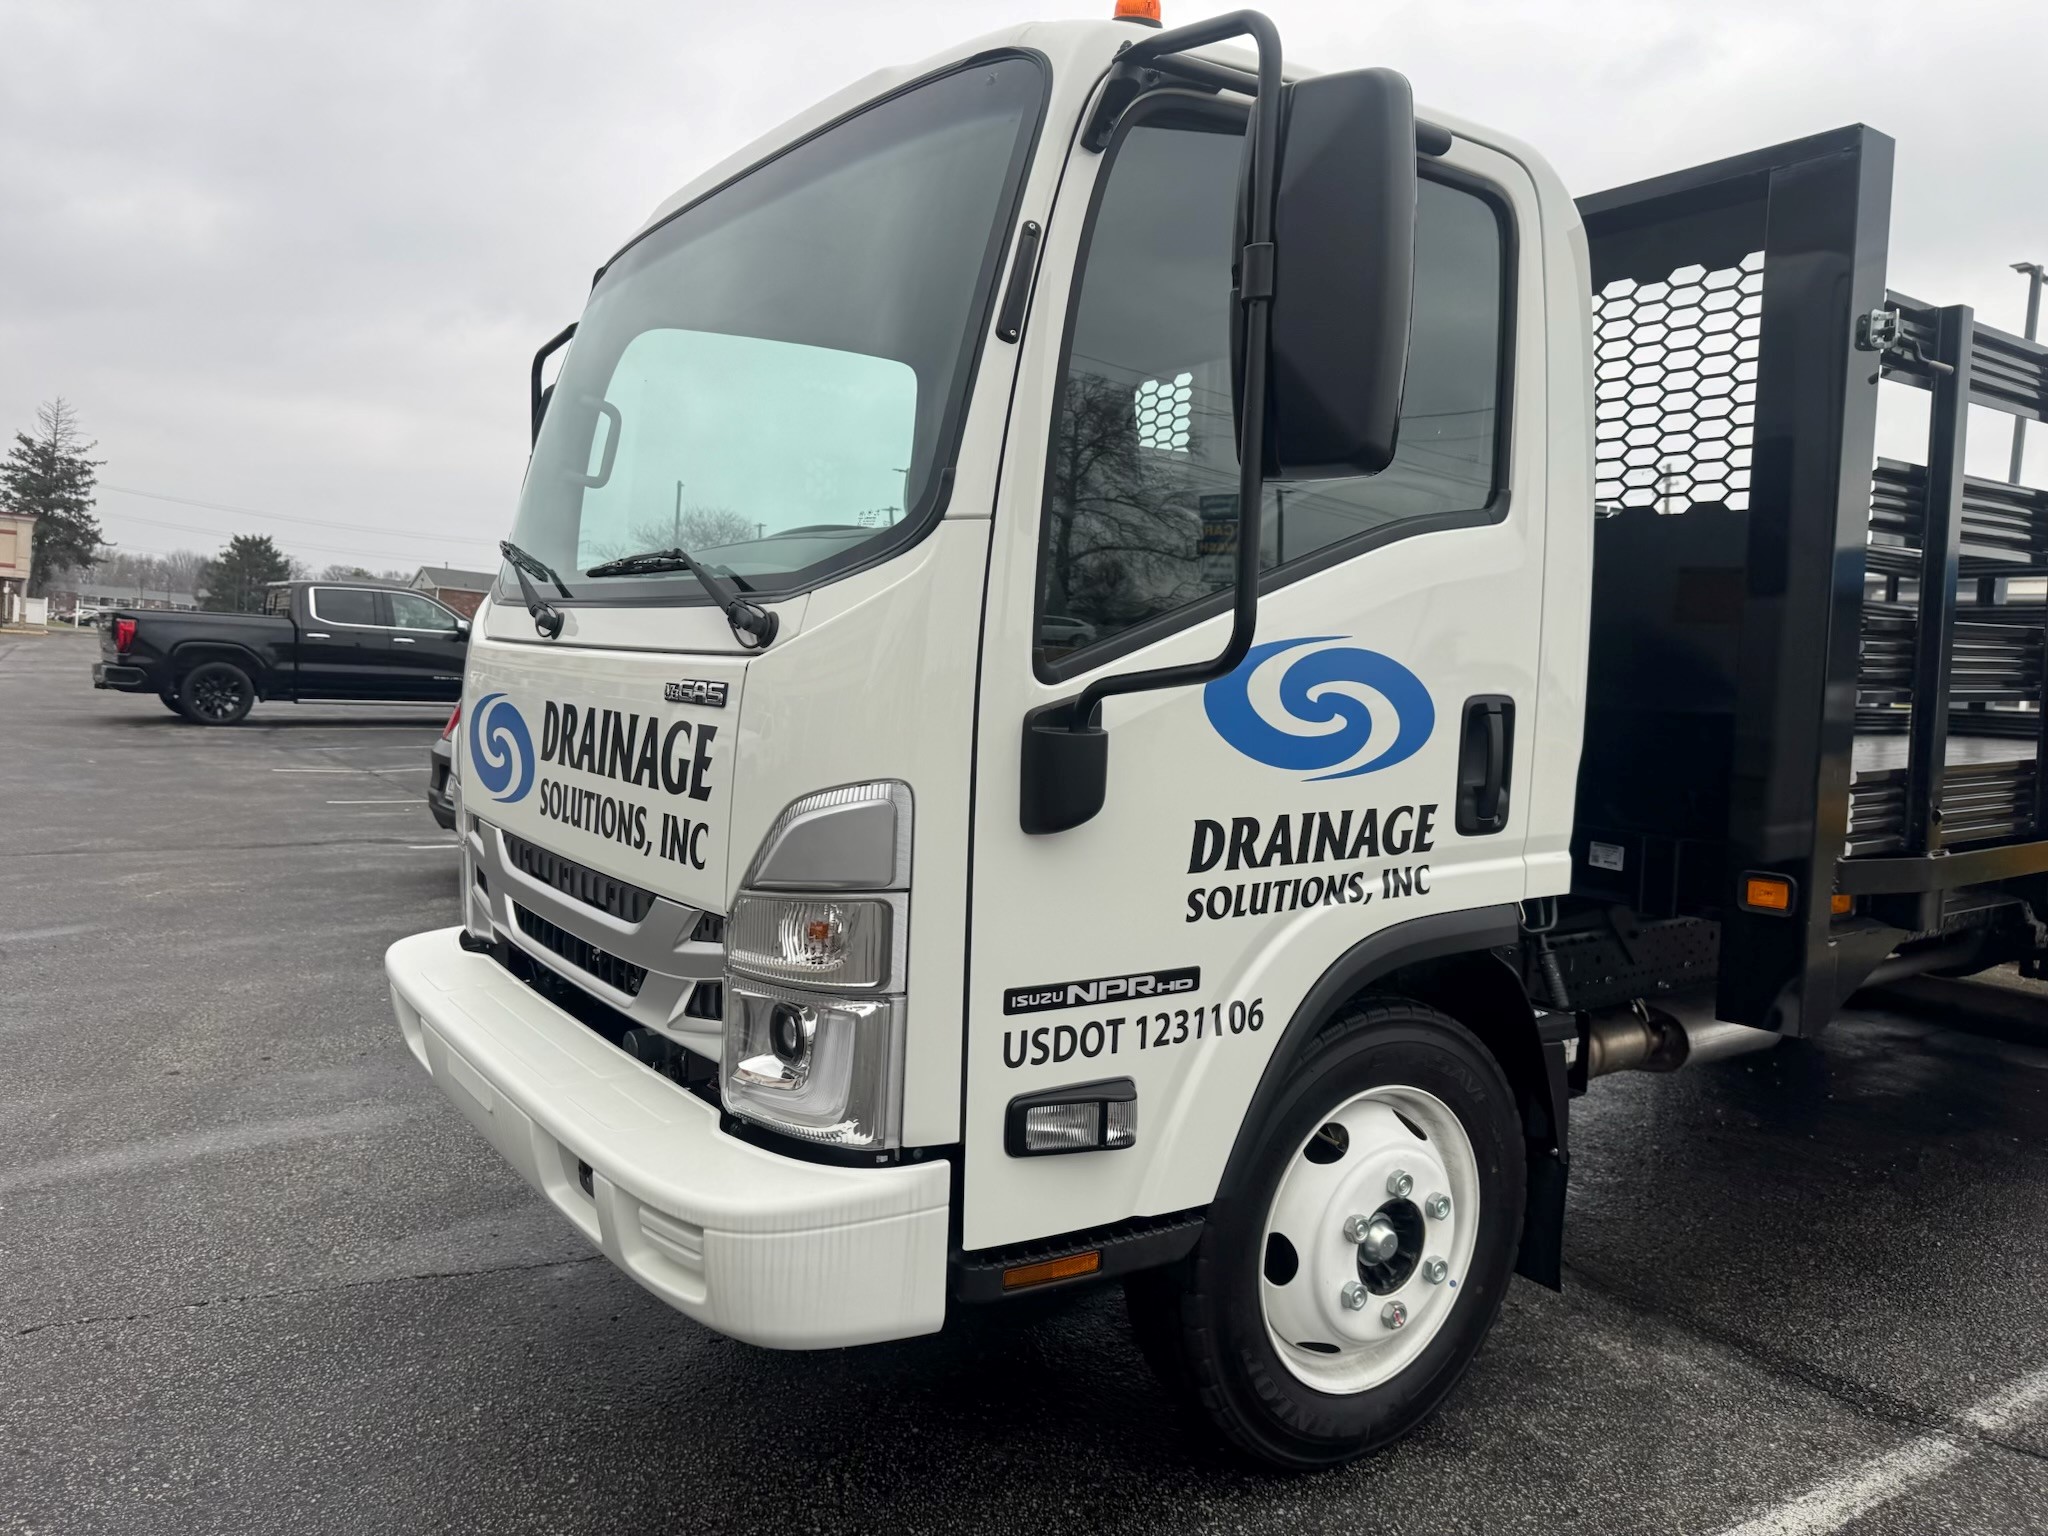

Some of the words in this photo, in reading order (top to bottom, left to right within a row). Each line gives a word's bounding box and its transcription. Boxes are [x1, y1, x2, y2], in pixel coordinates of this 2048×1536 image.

[541, 700, 718, 802] DRAINAGE
[540, 778, 652, 856] SOLUTIONS,
[660, 813, 709, 870] INC
[1187, 804, 1438, 874] DRAINAGE
[1186, 872, 1373, 923] SOLUTIONS,
[1383, 865, 1430, 899] INC
[1003, 1017, 1126, 1068] USDOT
[1136, 997, 1264, 1050] 1231106
[1012, 991, 1063, 1008] ISUZU
